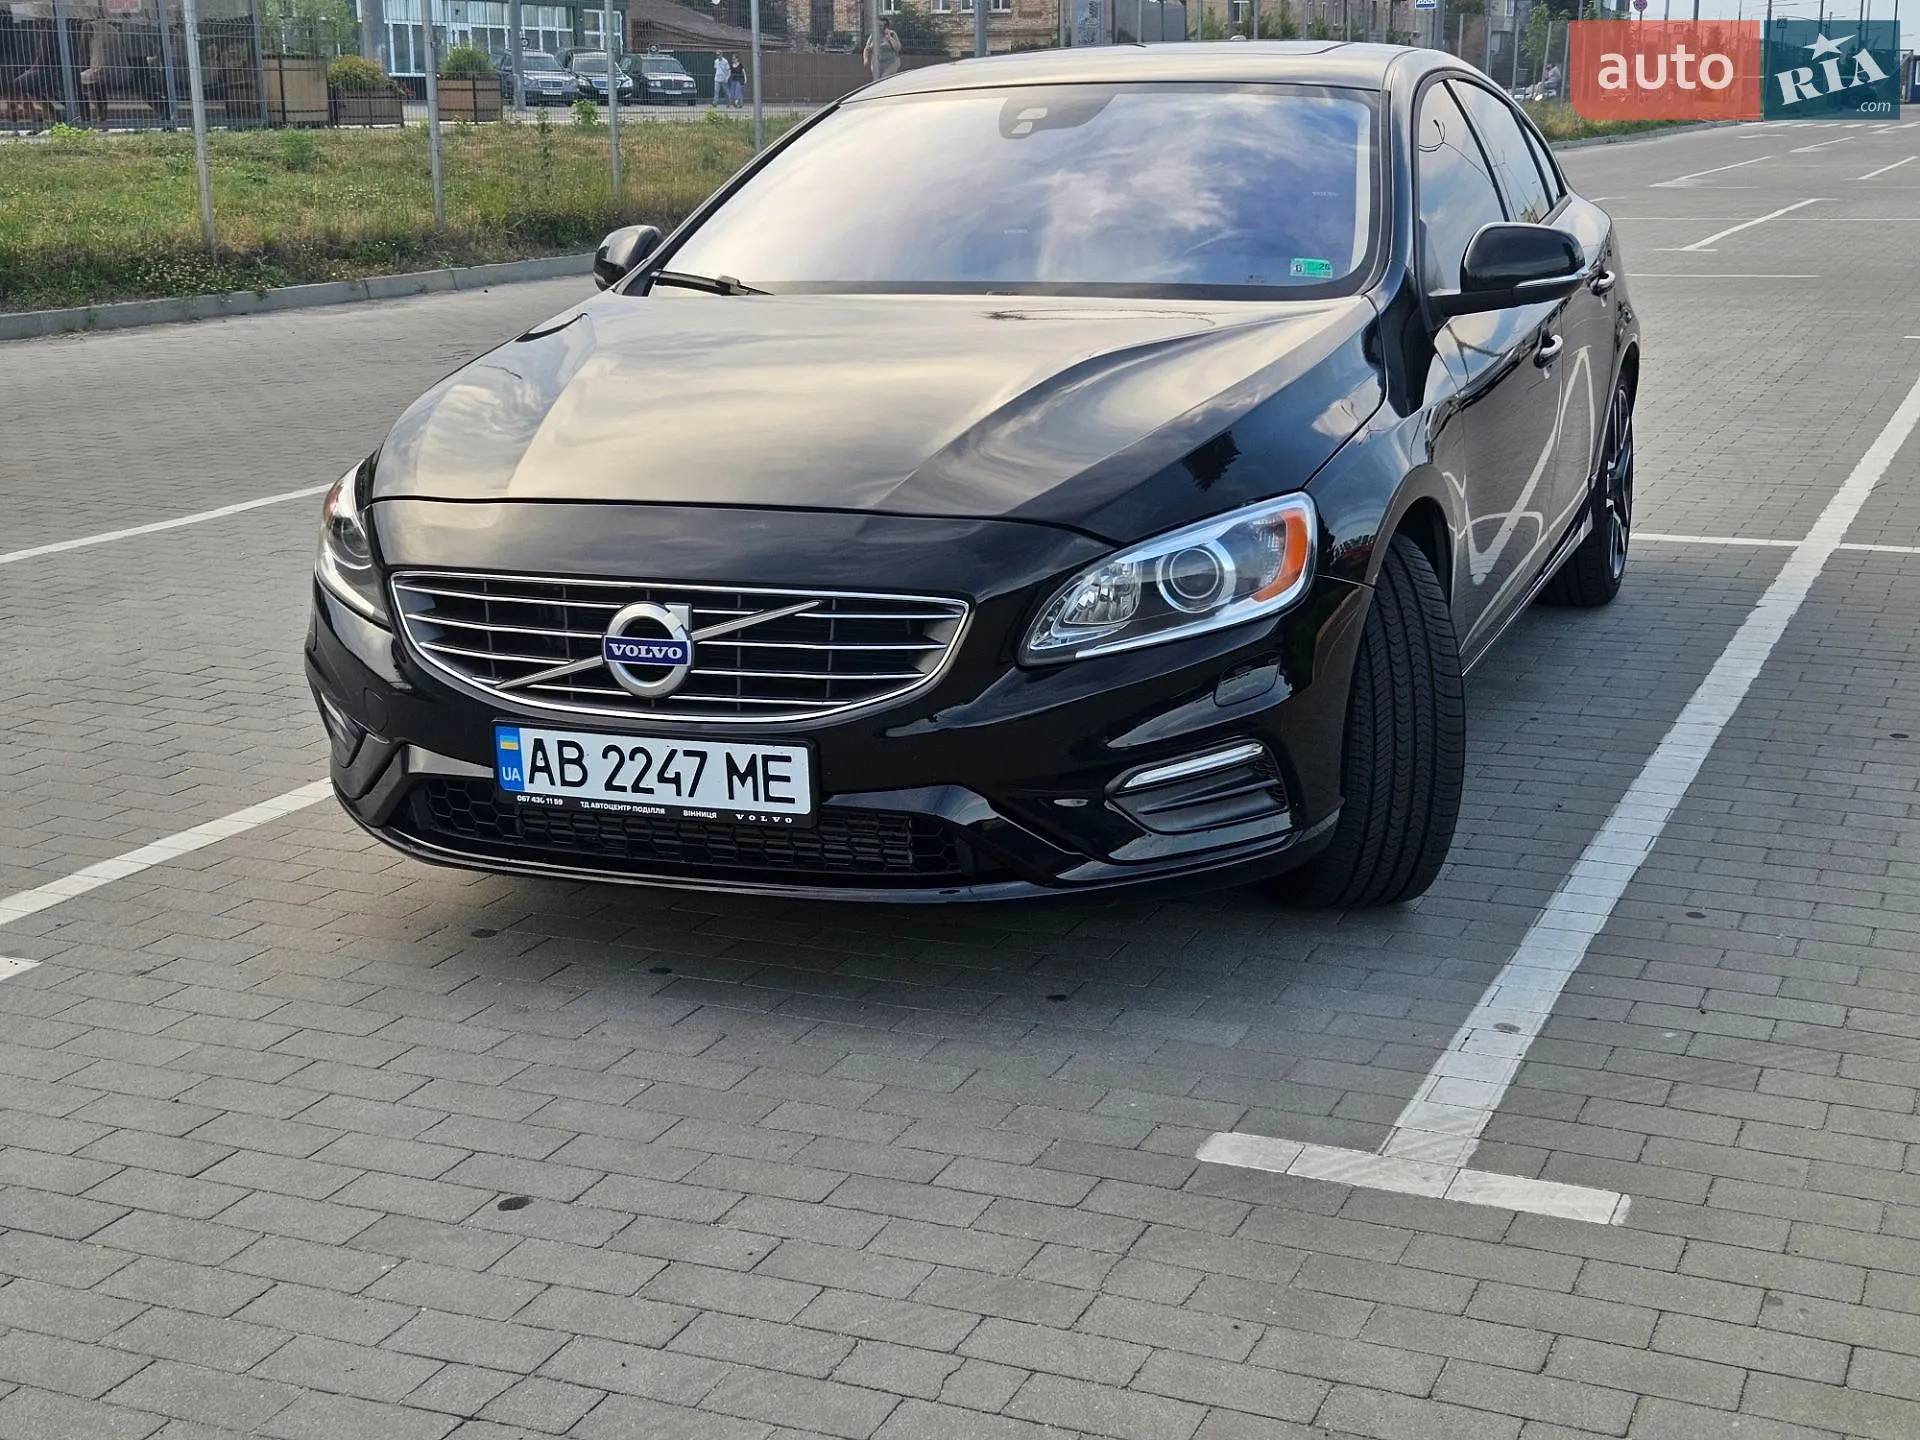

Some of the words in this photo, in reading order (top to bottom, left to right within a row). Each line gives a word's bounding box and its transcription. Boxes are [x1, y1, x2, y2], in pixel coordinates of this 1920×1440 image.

[609, 643, 683, 660] VOLVO
[502, 767, 522, 782] UA
[528, 737, 589, 788] AB
[601, 743, 709, 798] 2247
[725, 751, 797, 804] ME
[516, 794, 531, 803] 067
[580, 801, 590, 809] ТД
[590, 803, 632, 812] АВТОЦЕНТР
[632, 806, 666, 815] ПОДІЛЛЯ
[682, 809, 718, 819] ВІННИЦЯ
[735, 813, 793, 824] VOLVO
